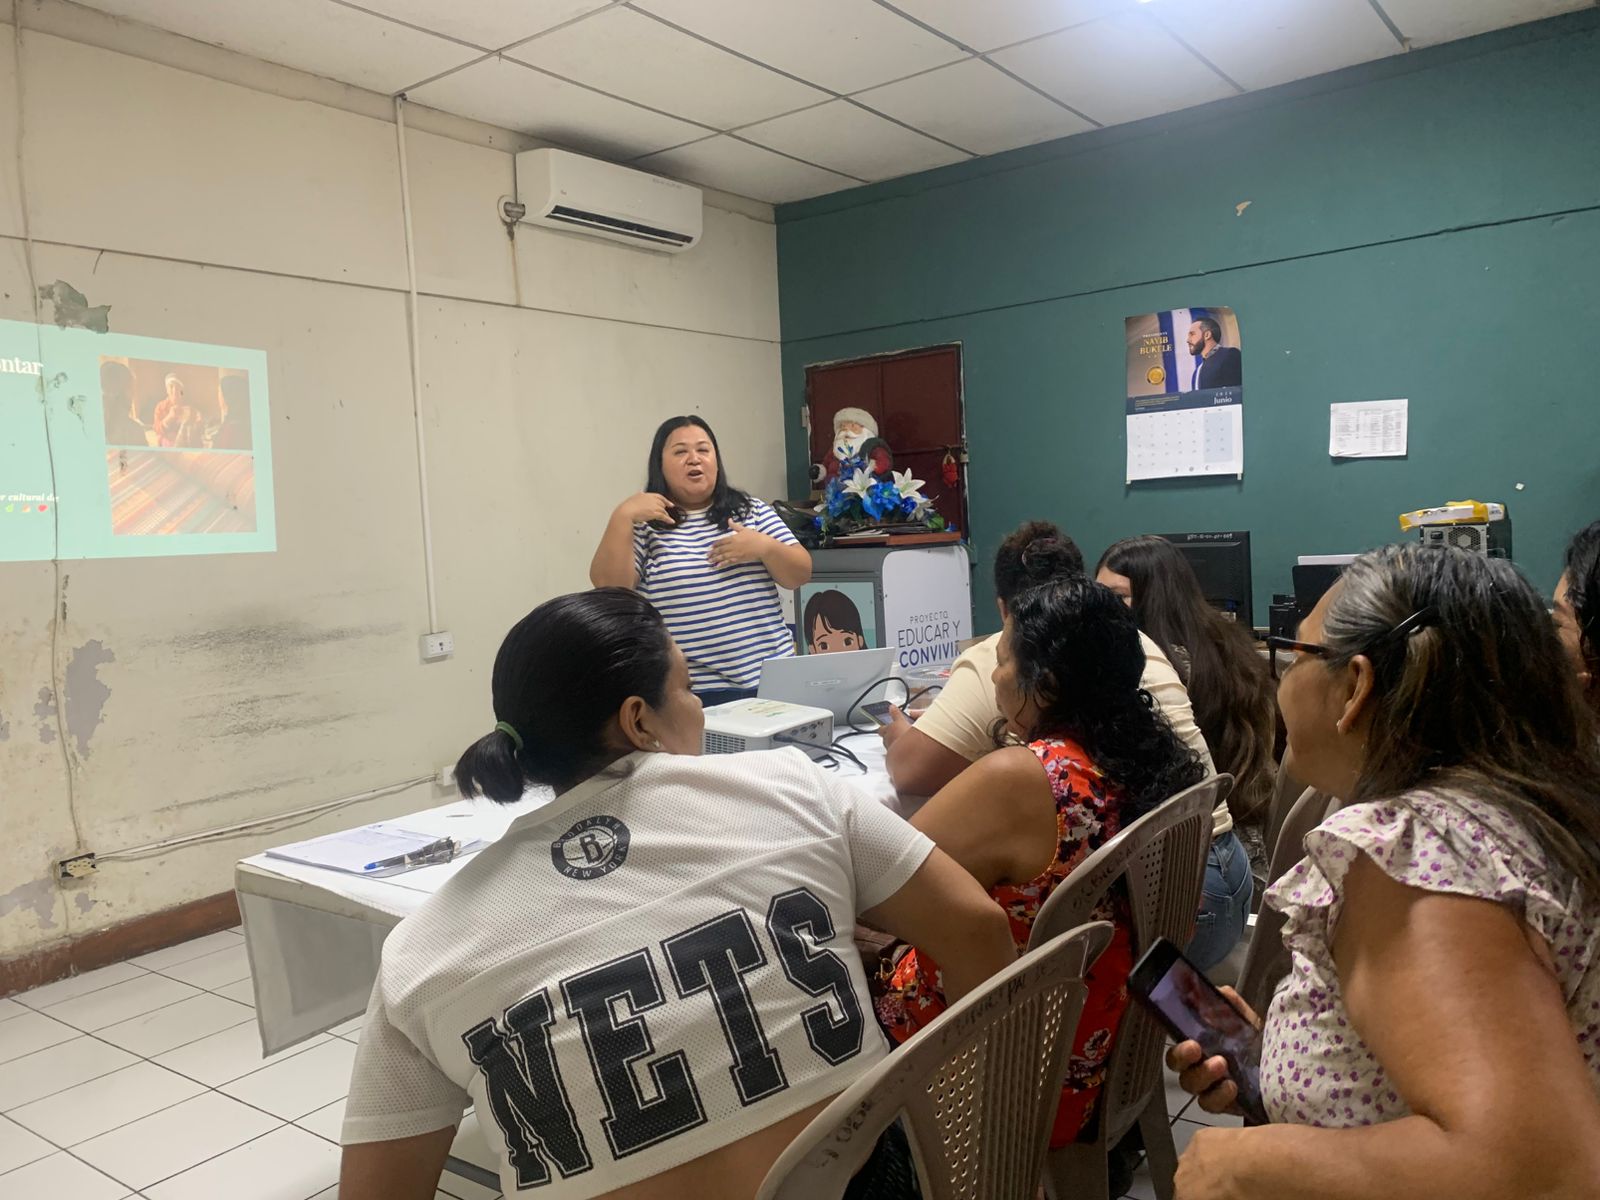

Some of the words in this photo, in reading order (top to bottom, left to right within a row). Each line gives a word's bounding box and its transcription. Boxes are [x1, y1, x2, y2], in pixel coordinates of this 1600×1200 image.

[0, 357, 44, 375] ntar
[1213, 395, 1233, 405] Junio
[8, 493, 45, 502] cultural
[910, 610, 948, 624] PROYECTO
[897, 622, 950, 648] EDUCAR
[952, 620, 960, 637] Y
[579, 833, 603, 864] B
[563, 866, 592, 877] NEW
[600, 846, 627, 873] YORK
[461, 886, 865, 1190] NETS
